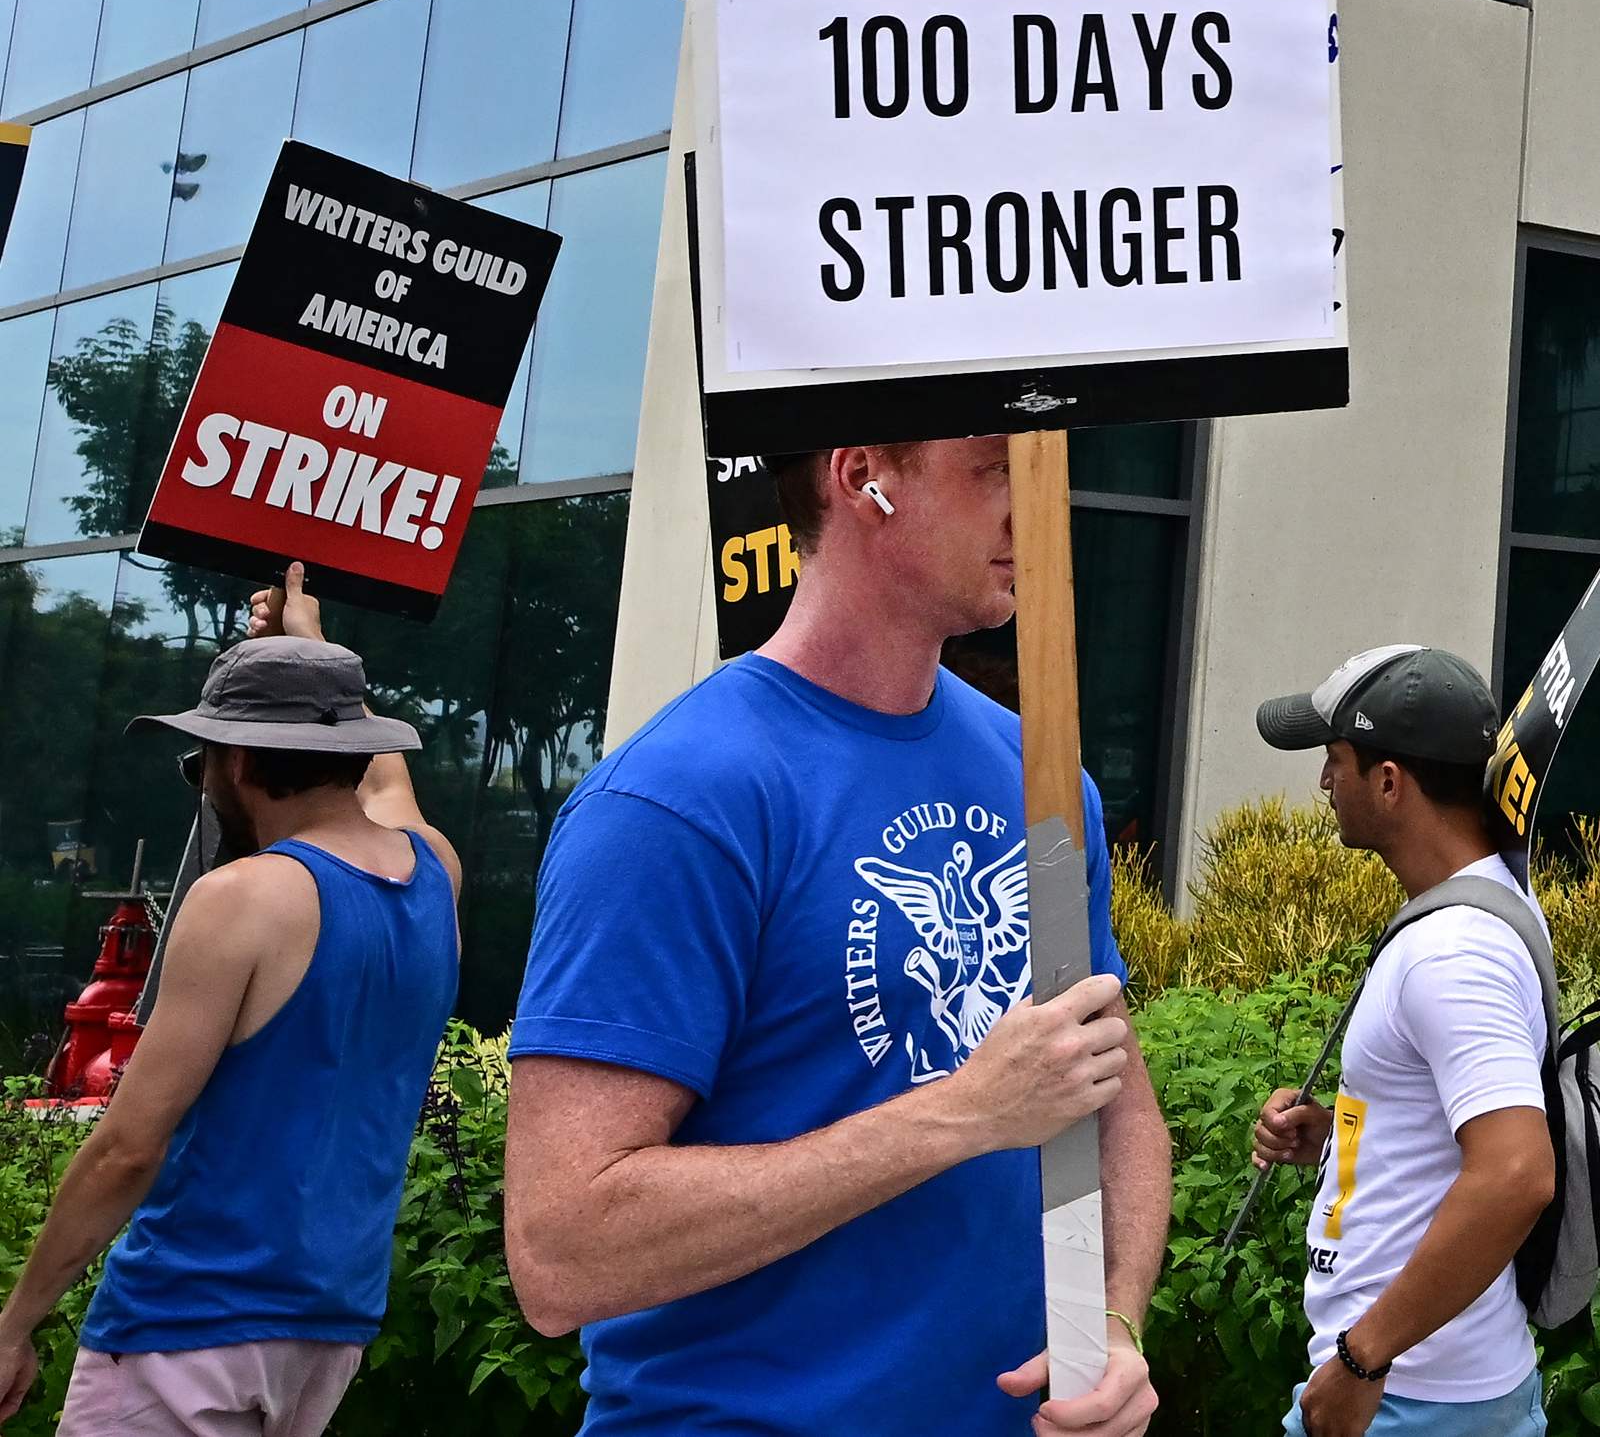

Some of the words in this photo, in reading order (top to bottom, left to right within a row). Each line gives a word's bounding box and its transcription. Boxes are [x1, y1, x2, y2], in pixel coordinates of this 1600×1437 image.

[819, 16, 969, 119] 100
[1015, 11, 1234, 115] DAYS
[284, 184, 430, 264] WRITERS
[432, 240, 527, 296] GUILD
[375, 270, 412, 303] OF
[818, 185, 1242, 302] STRONGER
[299, 293, 448, 370] AMERICA
[322, 385, 388, 439] ON
[180, 412, 462, 551] STRIKE!
[845, 898, 894, 1068] WRITERS
[881, 801, 957, 855] GUILD
[964, 804, 1008, 839] OF
